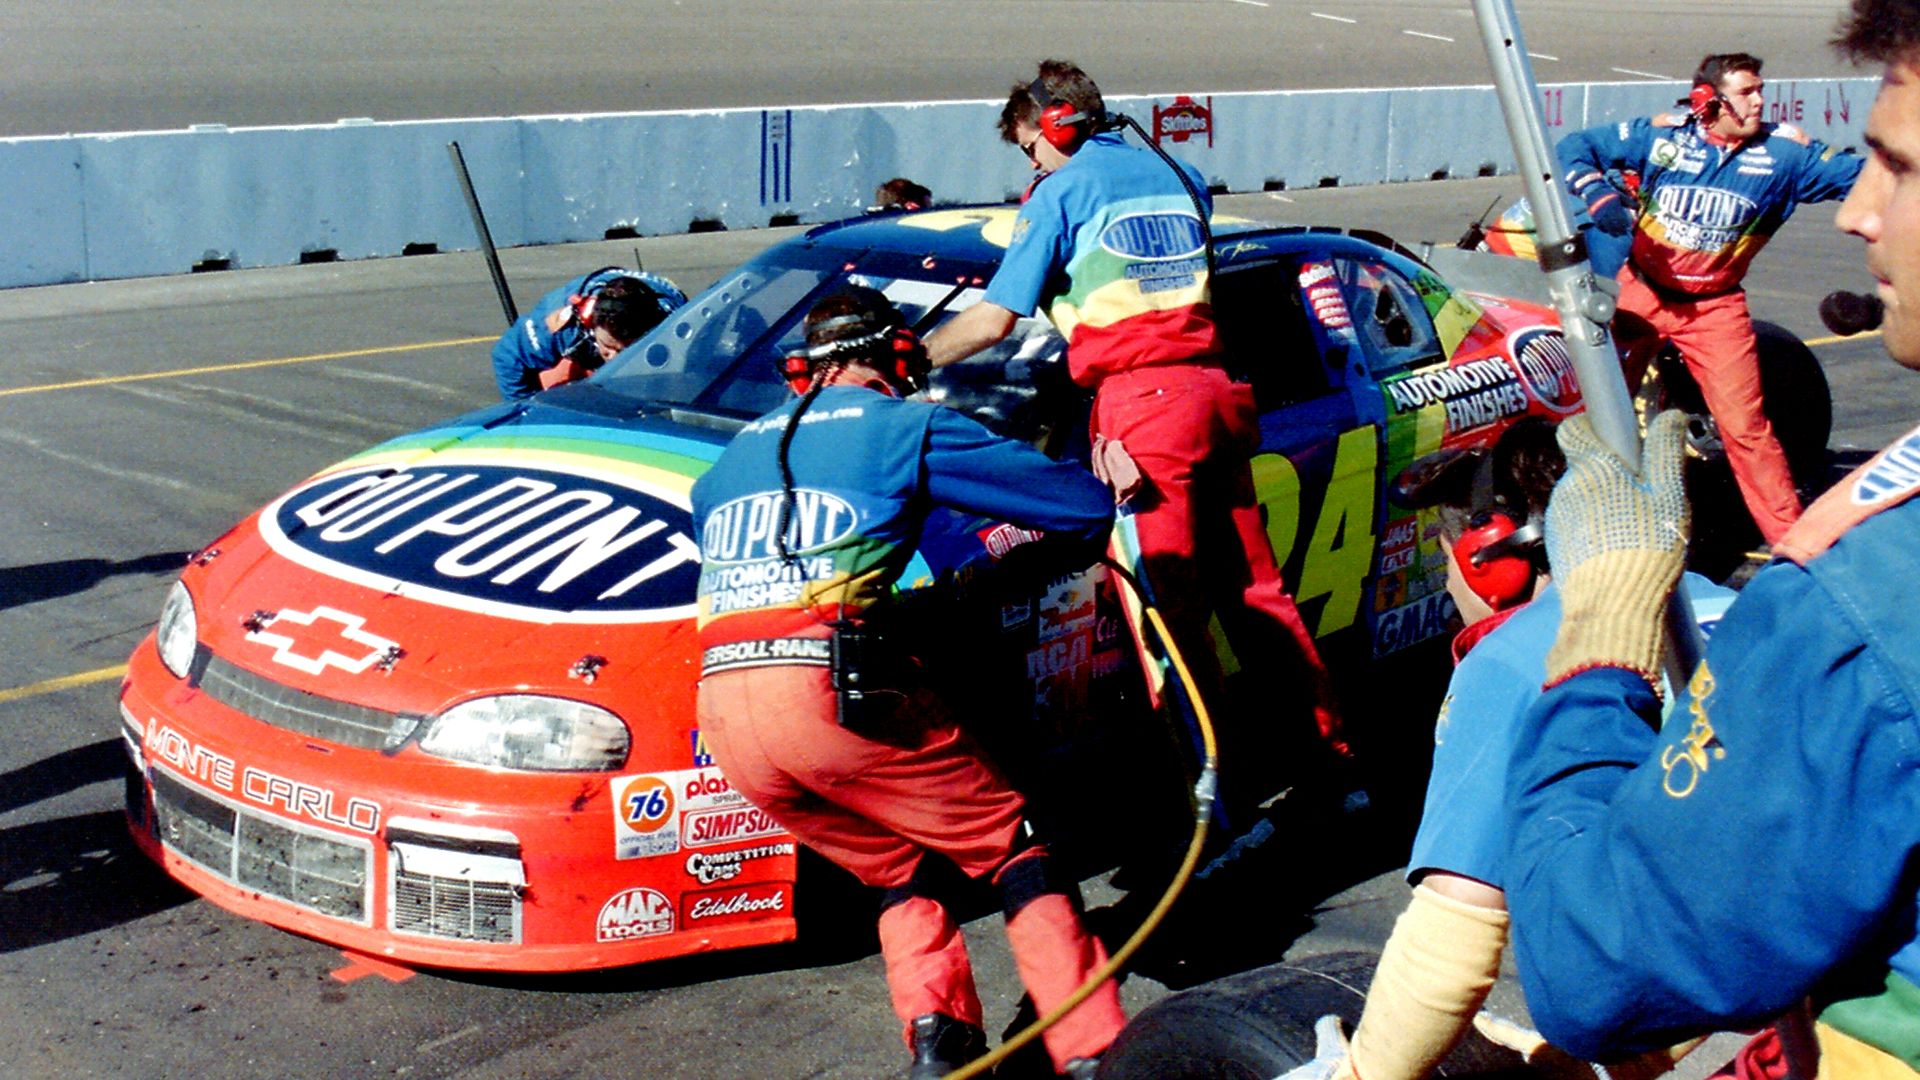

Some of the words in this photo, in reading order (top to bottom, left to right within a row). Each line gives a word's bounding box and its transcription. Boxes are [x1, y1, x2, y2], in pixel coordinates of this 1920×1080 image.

[1387, 356, 1517, 412] AUTOMOTIVE
[1446, 382, 1528, 432] FINISHES
[711, 581, 802, 613] FINISHES
[1379, 593, 1455, 651] GMAC
[146, 717, 235, 791] MONTE
[243, 766, 381, 834] CARLO
[628, 788, 668, 822] 76
[601, 891, 671, 926] MAC
[691, 891, 783, 919] Edelbrock
[601, 919, 670, 938] TOOLS
